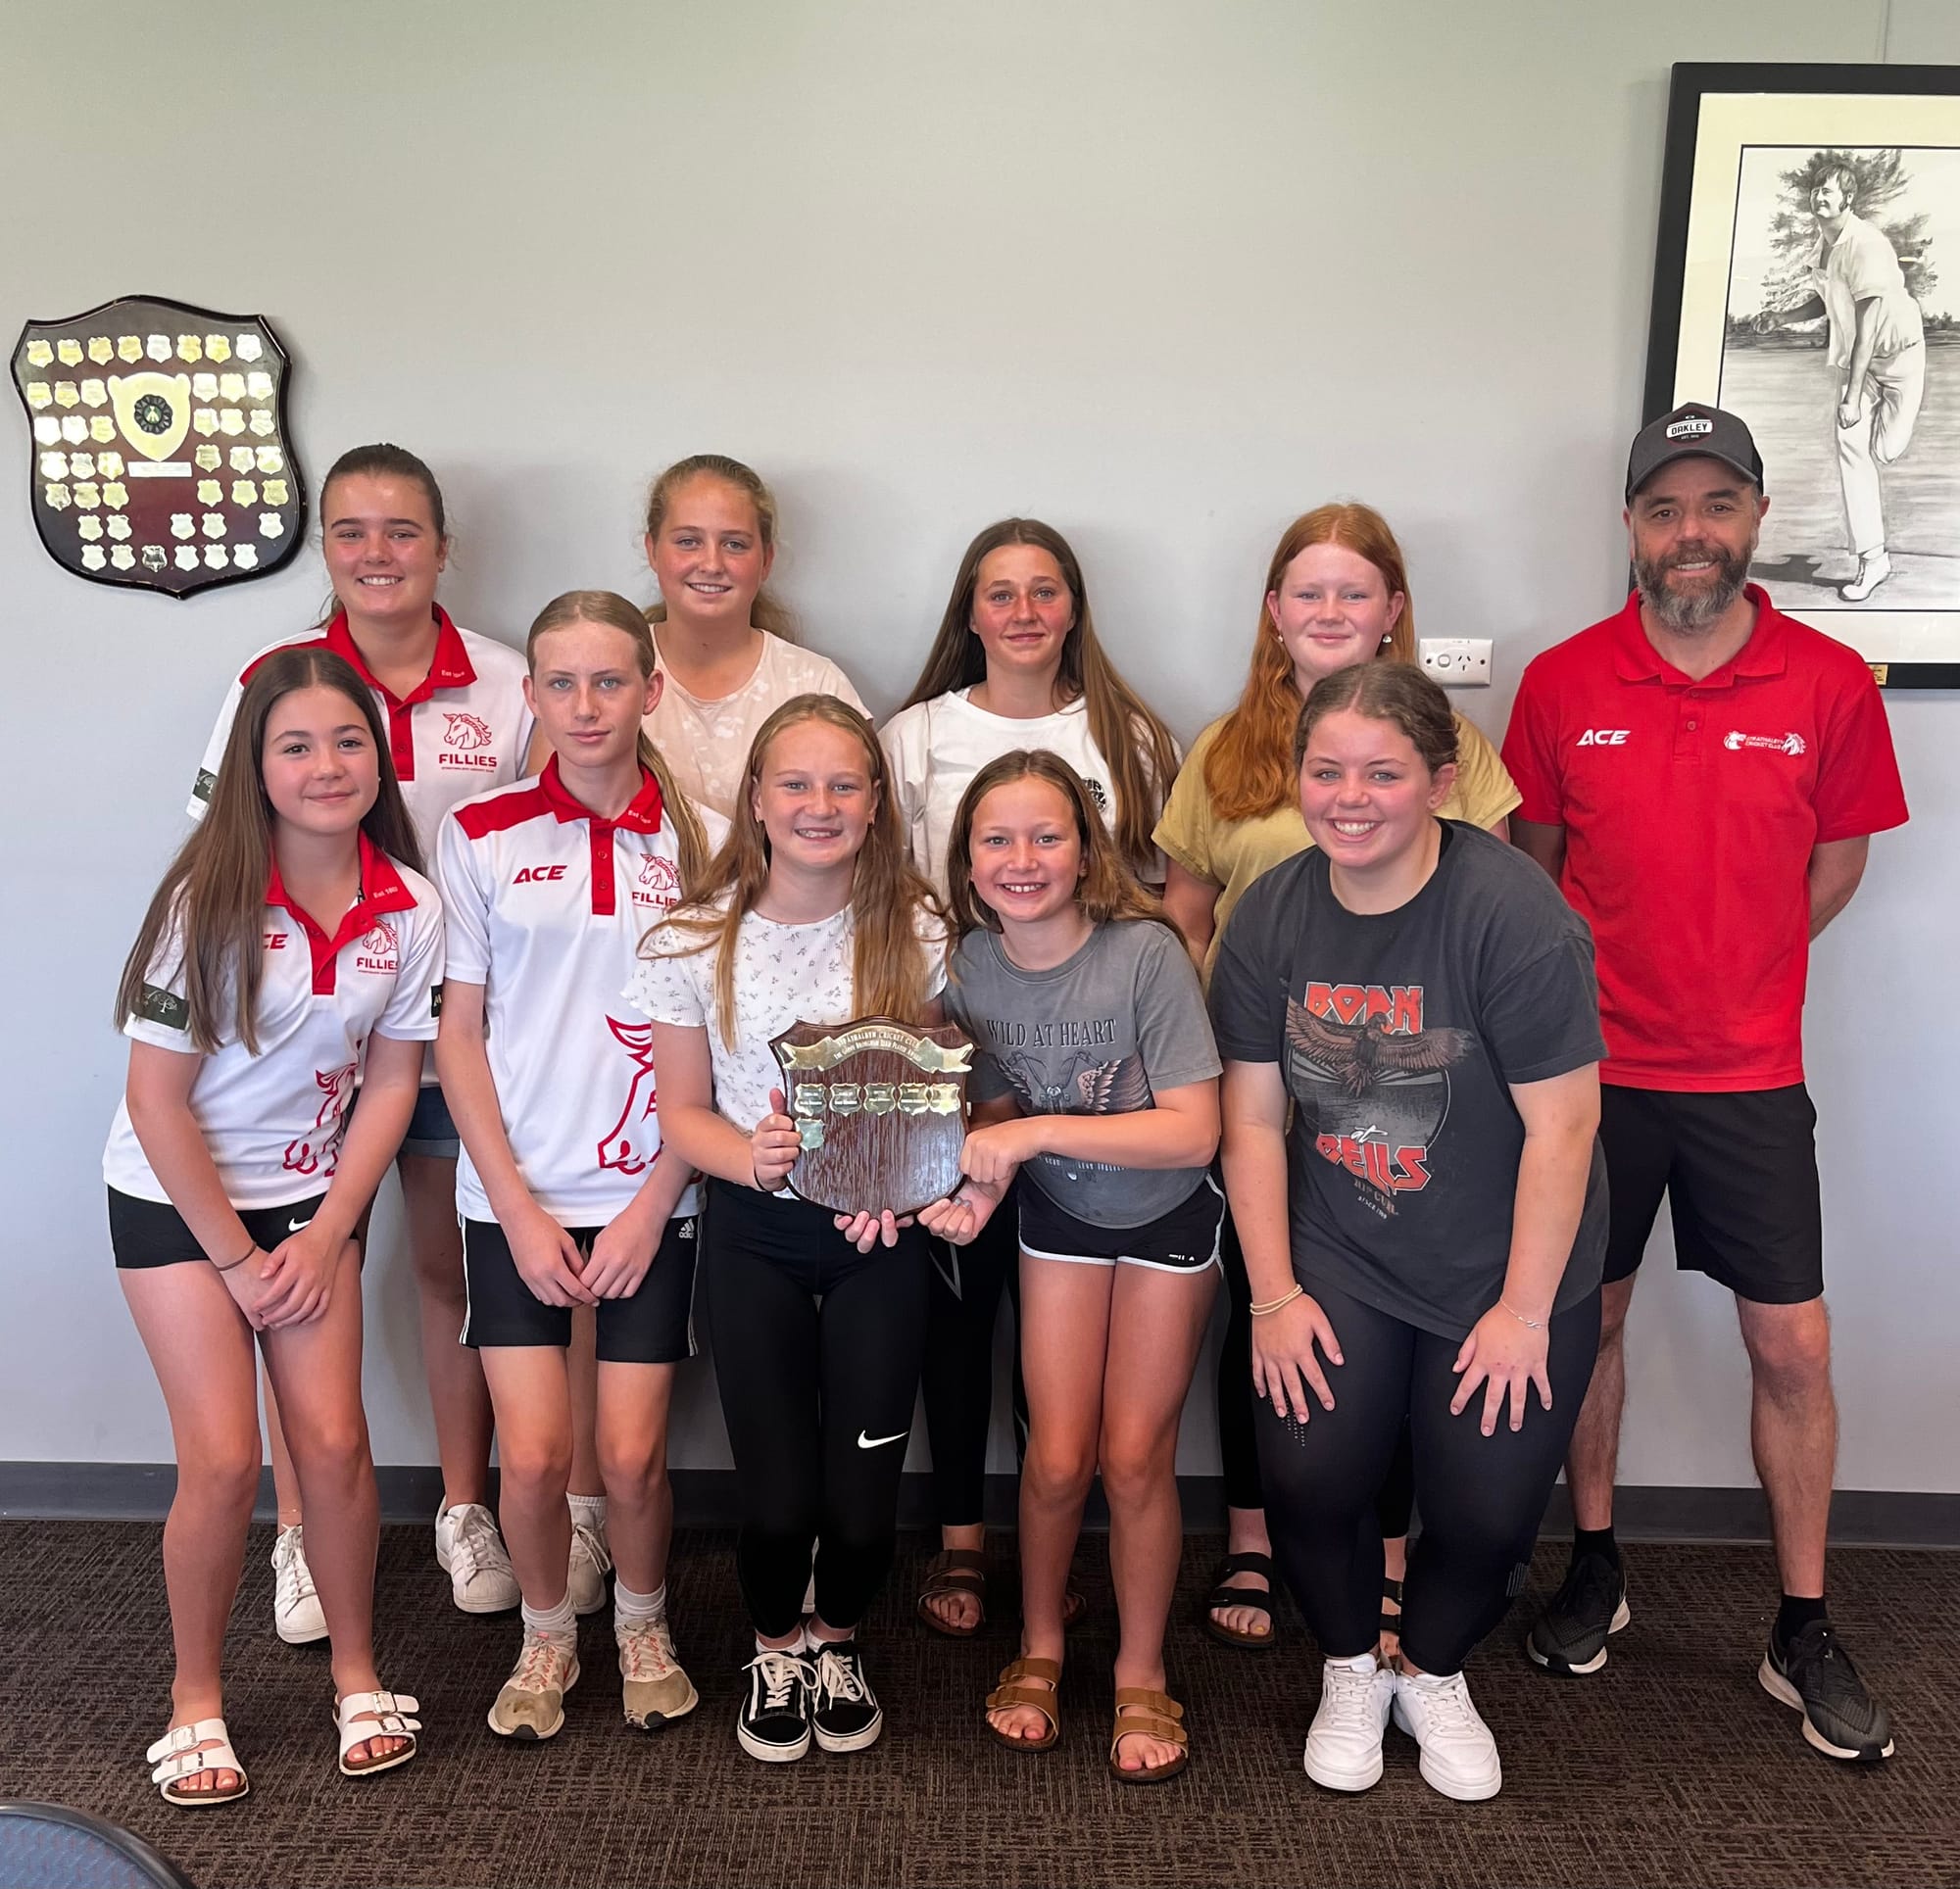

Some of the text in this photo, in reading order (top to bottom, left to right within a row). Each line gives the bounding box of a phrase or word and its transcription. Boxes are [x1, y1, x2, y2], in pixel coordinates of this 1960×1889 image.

[1672, 423, 1707, 435] OAKLEY
[1576, 729, 1631, 747] ACE
[438, 753, 498, 767] FILLIES
[513, 865, 568, 885] ACE
[632, 891, 678, 906] FILLIE
[1304, 982, 1424, 1036] BORN
[986, 1018, 1117, 1048] WILD AT HEART
[1315, 1134, 1432, 1196] BELLS
